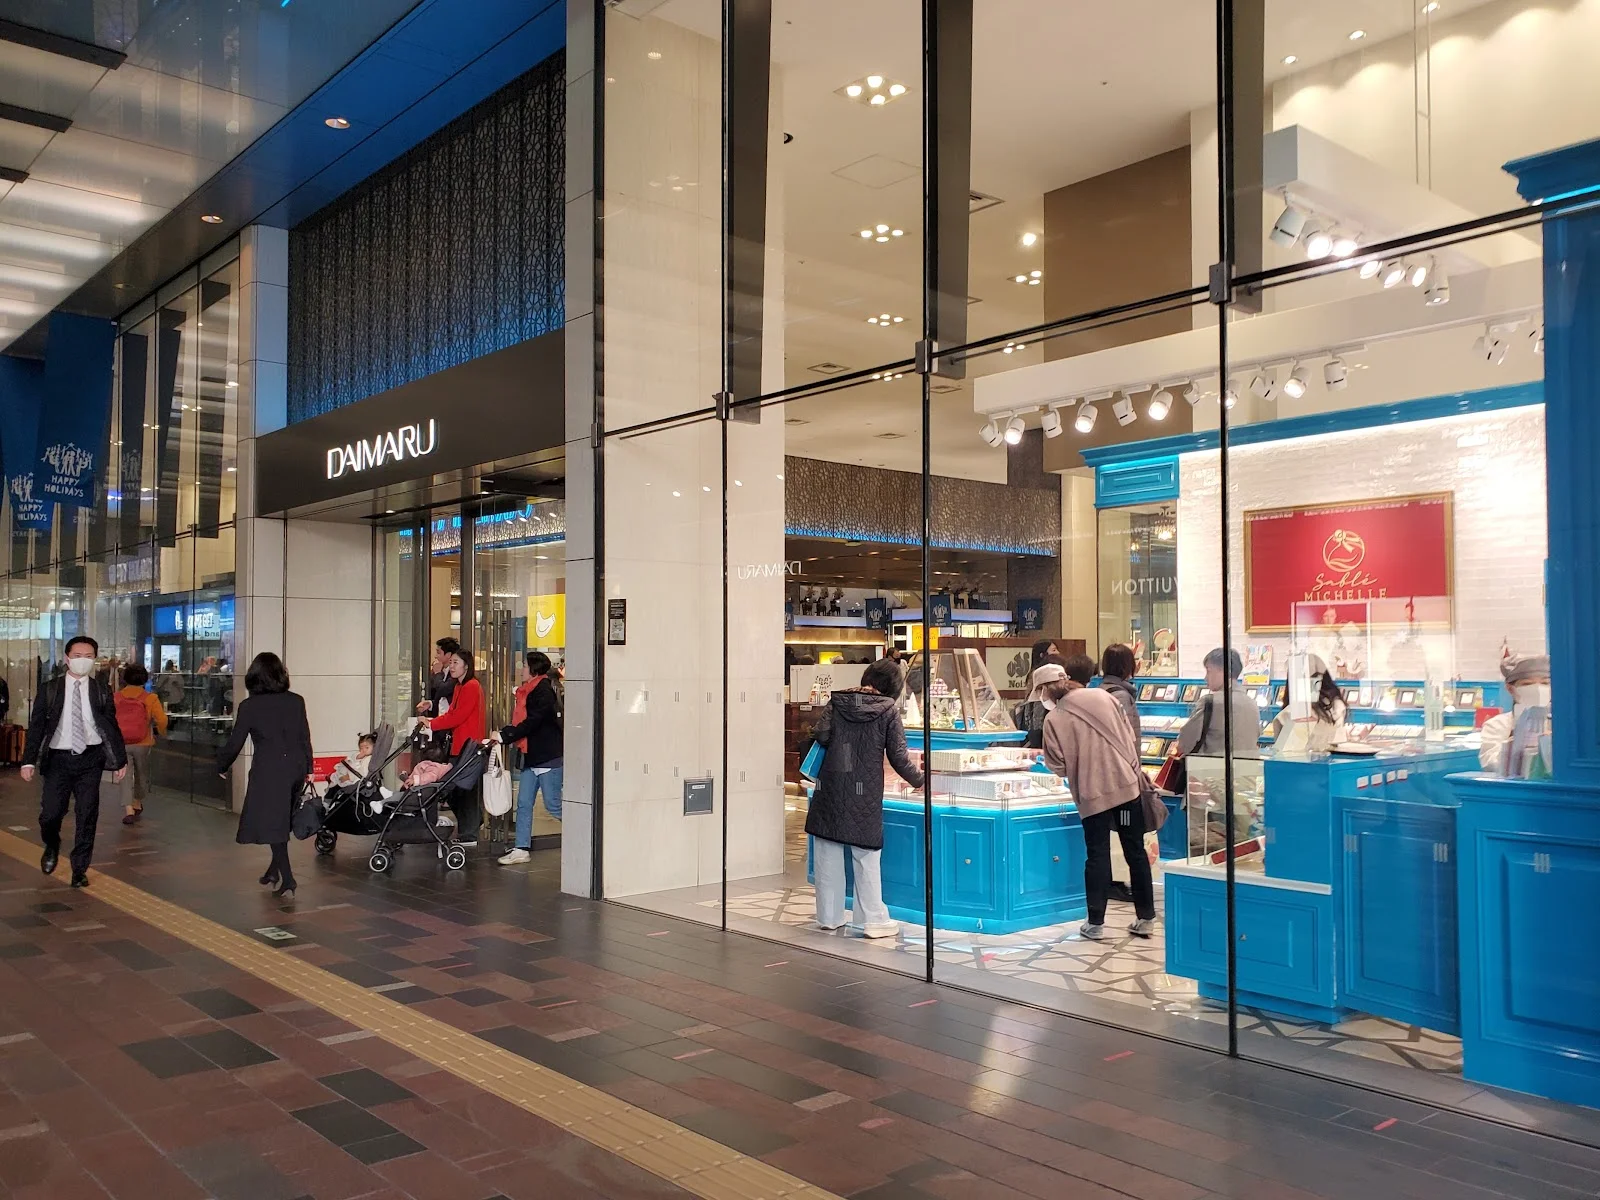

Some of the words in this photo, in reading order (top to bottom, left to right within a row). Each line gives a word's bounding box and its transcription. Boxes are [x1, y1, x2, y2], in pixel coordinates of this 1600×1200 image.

[327, 418, 435, 479] DAIMARU
[51, 475, 80, 486] HAPPY
[44, 483, 84, 497] HOLIDAYS
[1312, 570, 1378, 591] Sablé
[1304, 587, 1387, 602] MICHELLE
